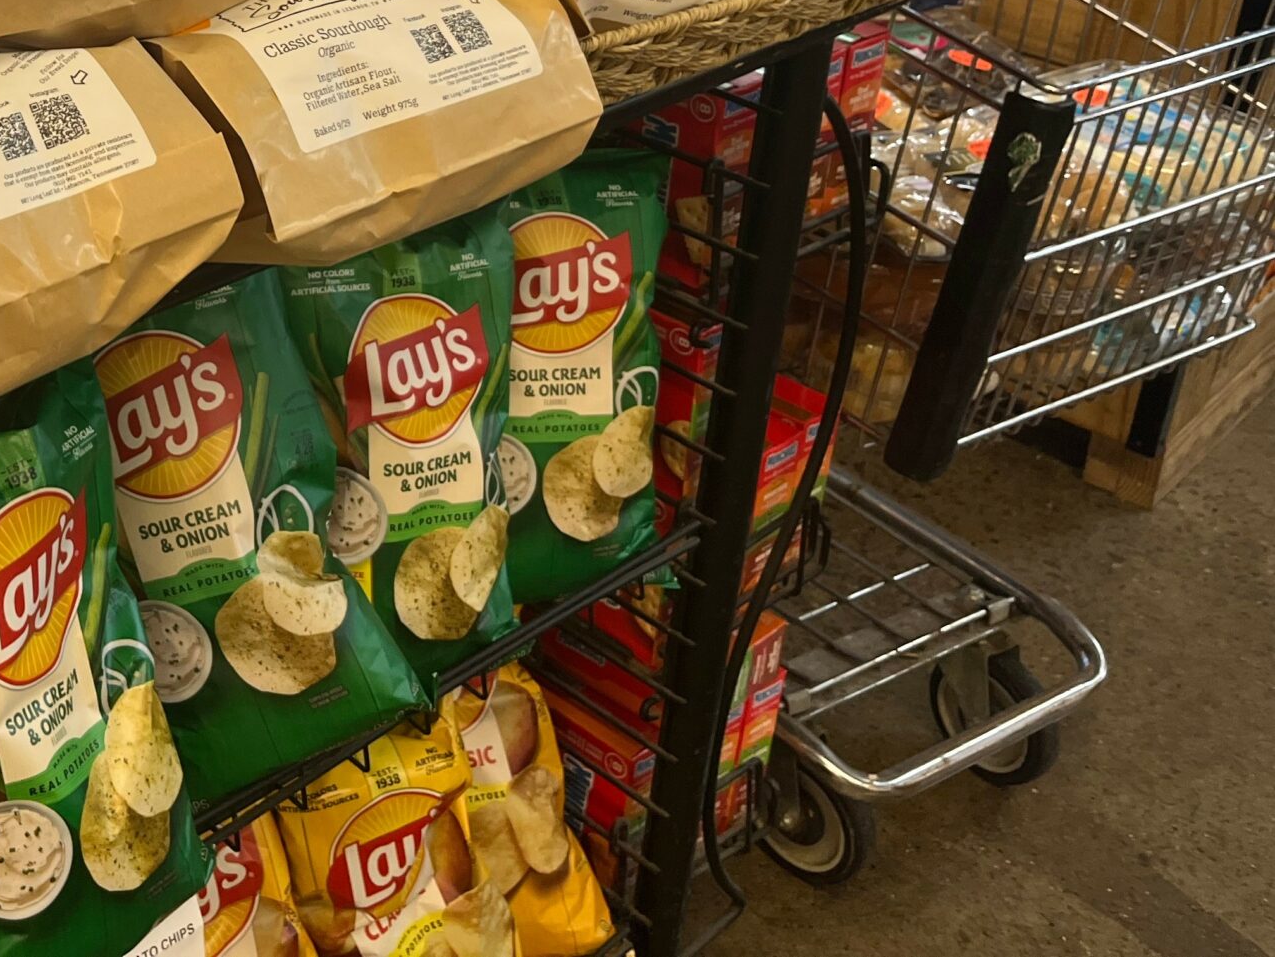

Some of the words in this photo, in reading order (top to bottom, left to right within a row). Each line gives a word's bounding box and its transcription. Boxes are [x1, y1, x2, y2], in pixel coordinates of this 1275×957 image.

[263, 33, 317, 59] Classic
[320, 13, 392, 42] Sourdough
[362, 102, 397, 121] Weight
[398, 97, 419, 112] 975g
[365, 319, 475, 416] Lay's
[552, 367, 601, 380] CREAM
[524, 385, 534, 396] &
[539, 383, 586, 395] ONION
[512, 424, 540, 433] REAL
[545, 423, 600, 433] POTATOES
[383, 462, 424, 477] SOUR
[428, 452, 472, 471] CREAM
[401, 480, 411, 492] &
[414, 470, 457, 488] ONION
[138, 515, 182, 540] SOUR
[185, 500, 241, 528] CREAM
[161, 538, 173, 553] &
[176, 522, 230, 549] ONION
[5, 700, 42, 736] SOUR
[44, 669, 79, 709] CREAM
[28, 728, 39, 745] &
[40, 701, 74, 734] ONION
[161, 923, 195, 950] CHIPS
